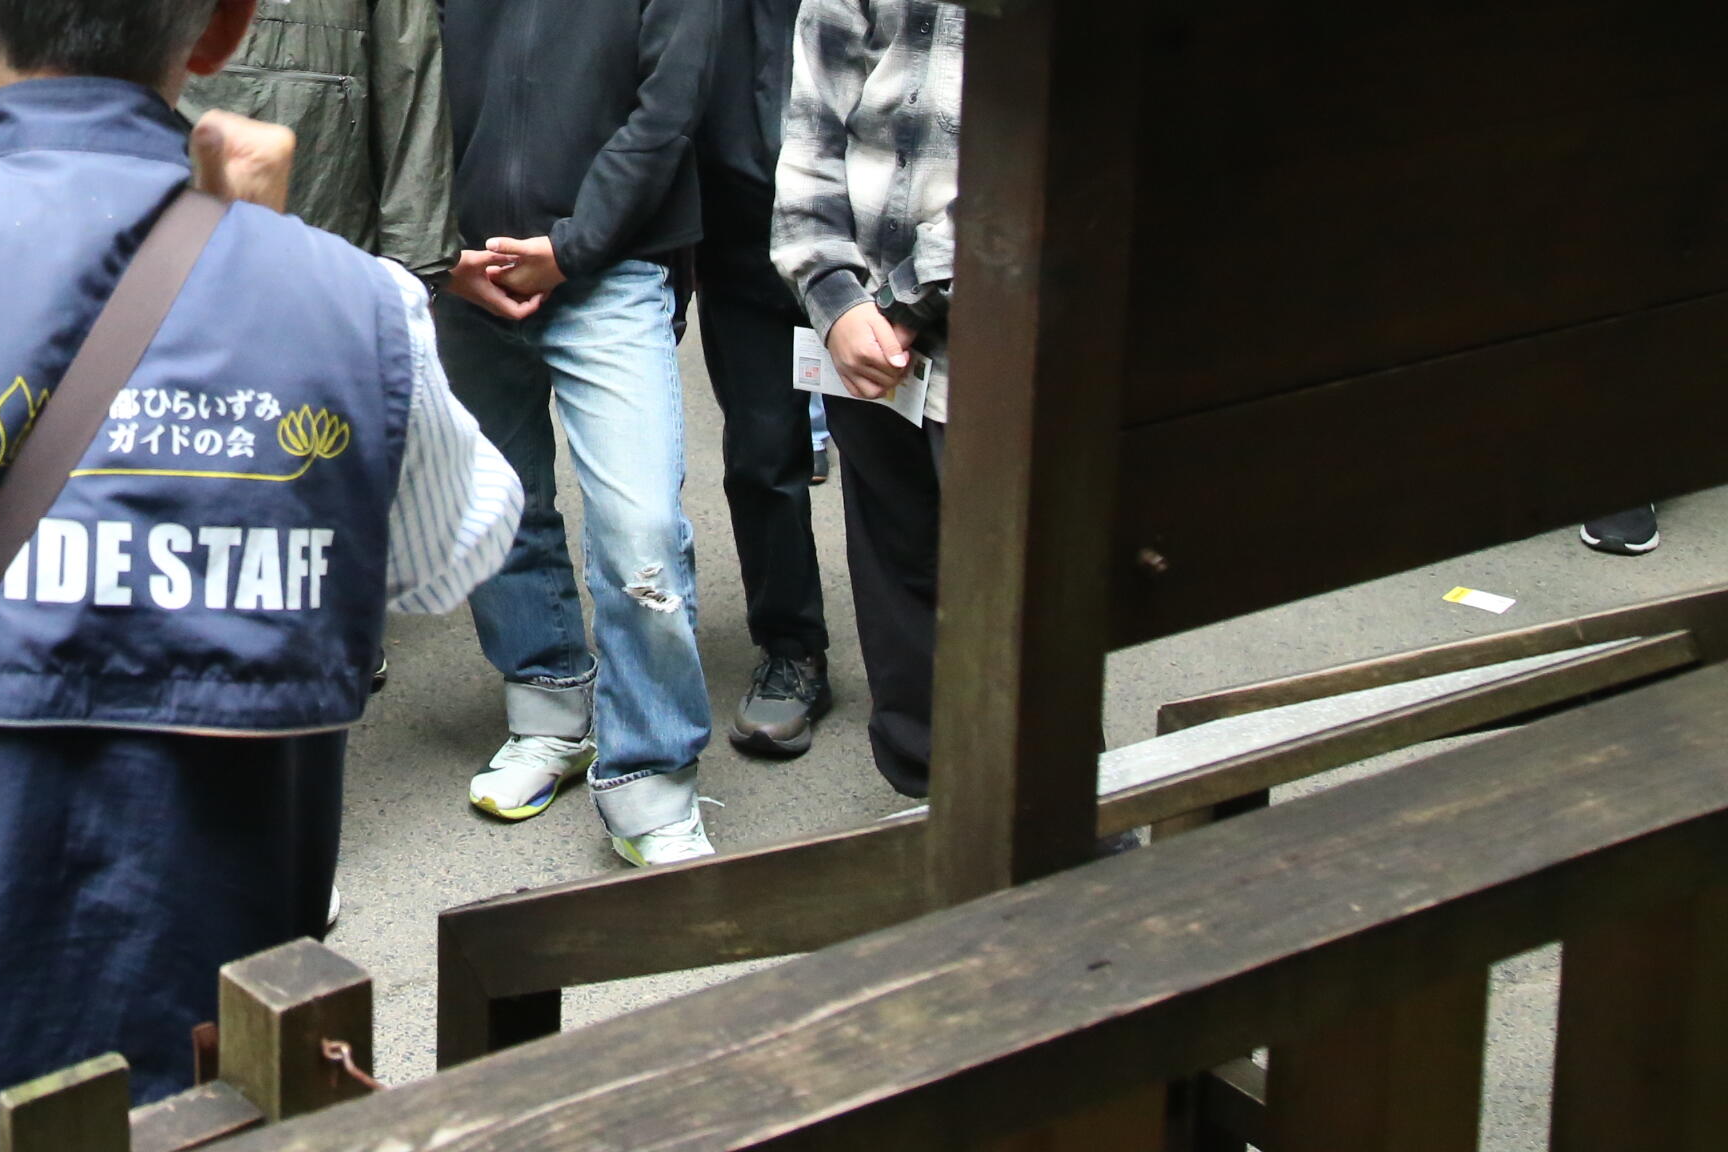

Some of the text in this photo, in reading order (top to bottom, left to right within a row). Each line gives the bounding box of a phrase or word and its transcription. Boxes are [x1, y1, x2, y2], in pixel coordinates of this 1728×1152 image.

[108, 421, 256, 458] ガイドの会
[148, 522, 334, 611] STAFF
